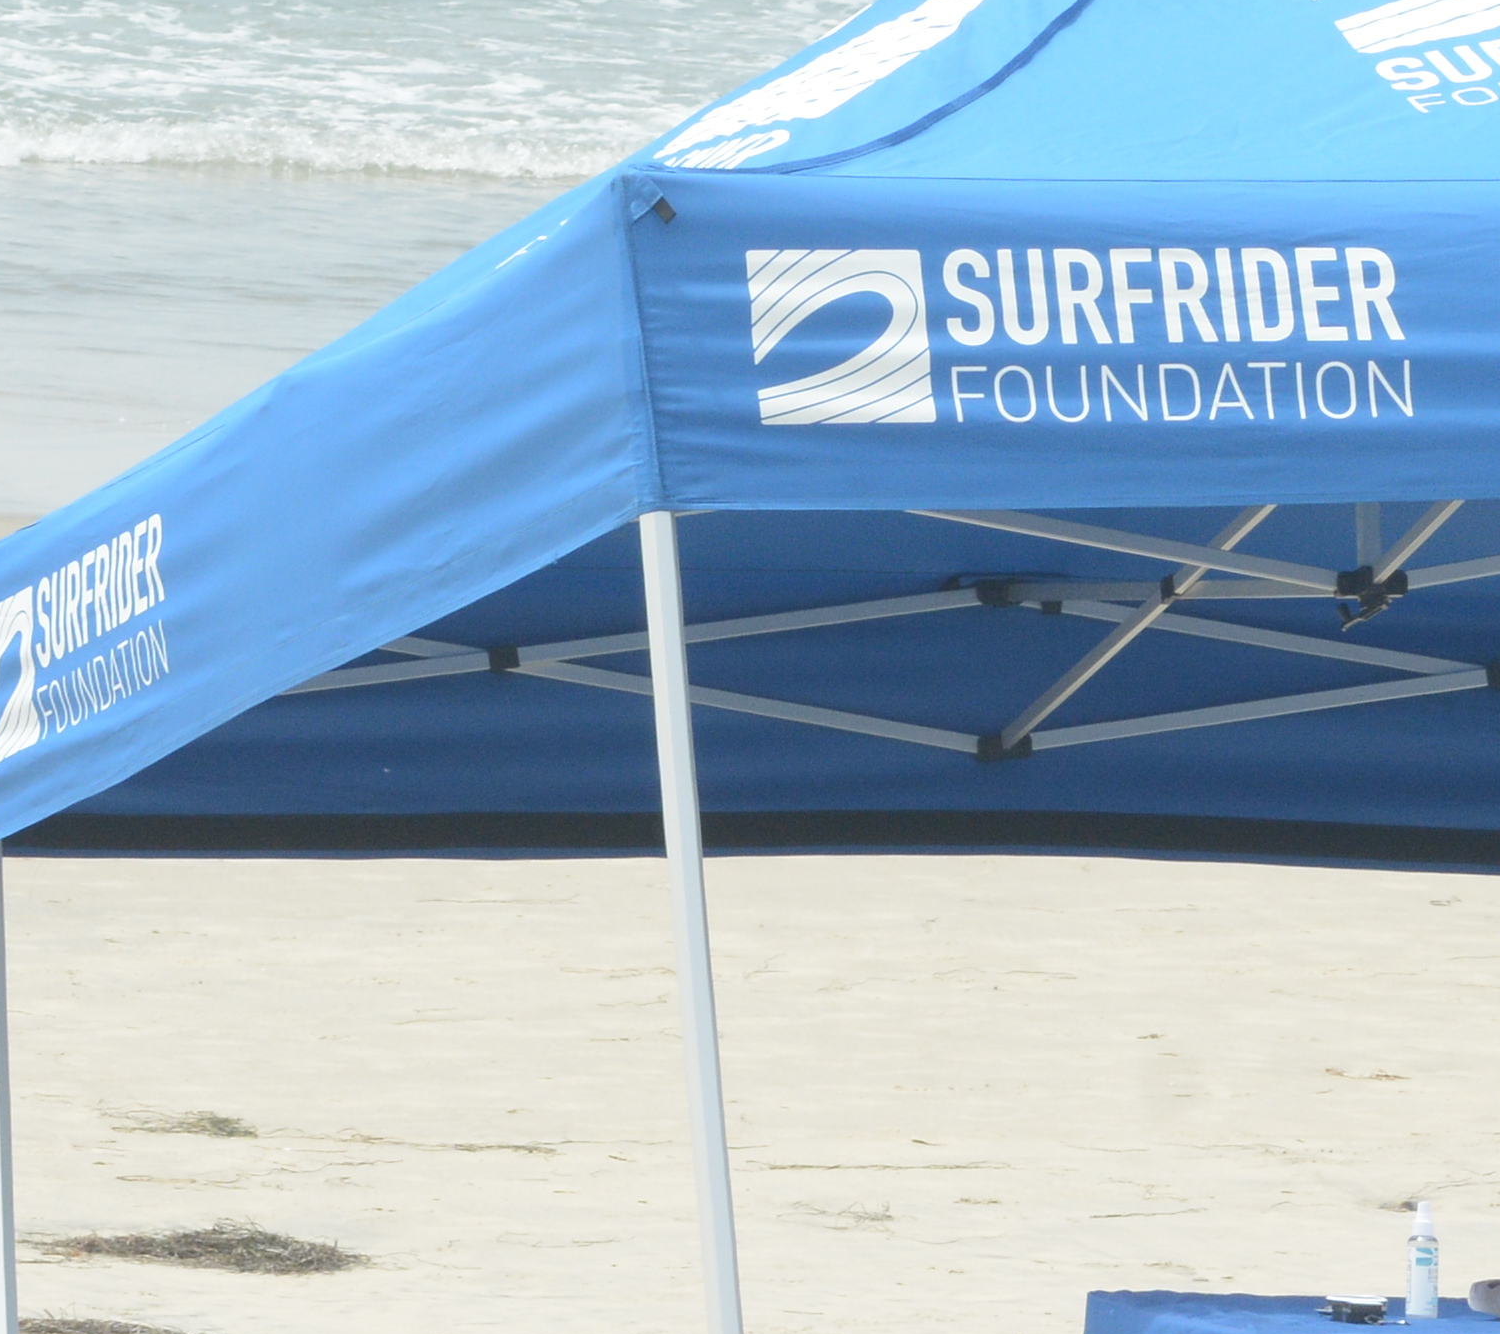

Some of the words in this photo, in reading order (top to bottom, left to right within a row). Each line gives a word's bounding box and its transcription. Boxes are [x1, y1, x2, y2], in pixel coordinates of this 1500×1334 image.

[944, 247, 1406, 346] SURFRIDER
[951, 359, 1414, 423] FOUNDATION
[35, 513, 166, 668] SURFRIDER
[36, 619, 170, 740] FOUNDATION
